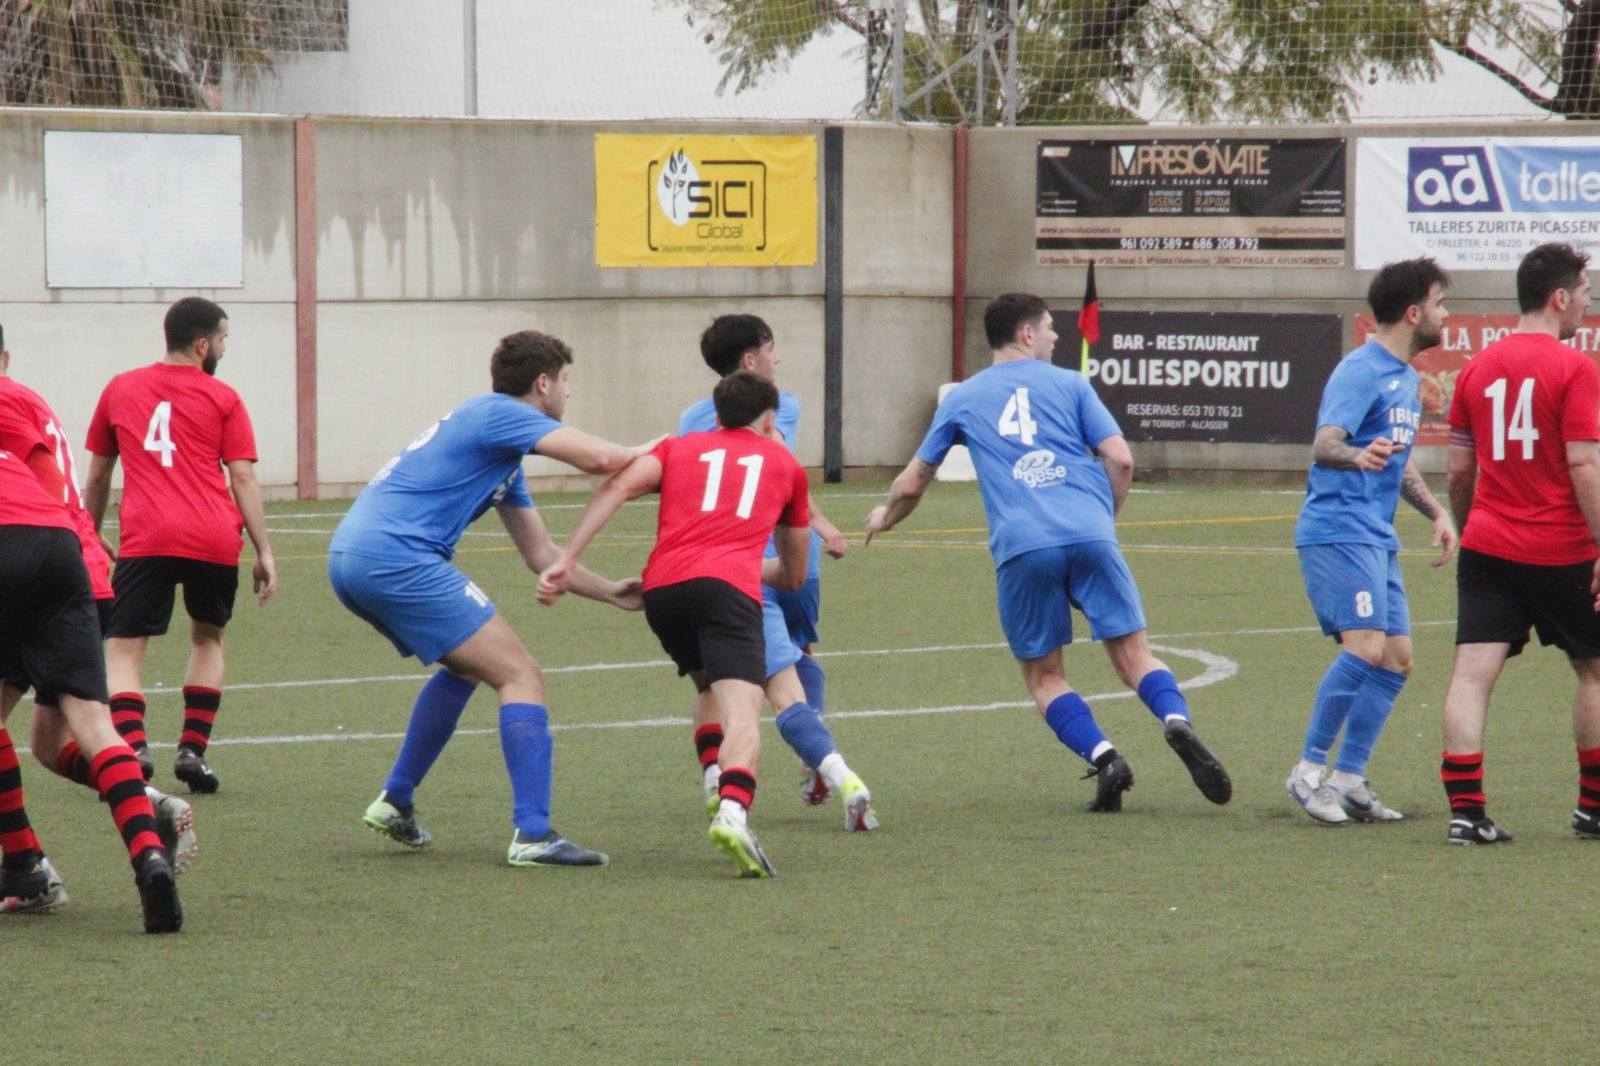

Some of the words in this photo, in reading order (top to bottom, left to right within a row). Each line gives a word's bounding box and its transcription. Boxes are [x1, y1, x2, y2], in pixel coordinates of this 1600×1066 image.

[1110, 141, 1270, 176] IMPRESIÓNATE
[1414, 154, 1490, 206] ad
[687, 181, 753, 218] SICI
[697, 223, 743, 239] Global
[1408, 221, 1474, 234] TALLERES
[1477, 221, 1526, 233] ZURITA
[1120, 238, 1137, 249] 961
[1140, 238, 1160, 249] 092
[1162, 238, 1182, 249] 589
[1192, 238, 1213, 250] 686
[1216, 238, 1236, 250] 208
[1239, 238, 1259, 250] 792
[1113, 335, 1144, 350] BAR
[1156, 335, 1259, 351] RESTAURANT
[1441, 327, 1471, 351] LA
[1088, 358, 1290, 389] POLIESPORTIU
[998, 388, 1037, 446] 4
[1127, 404, 1181, 416] RESERVAS:
[1182, 405, 1201, 416] 653
[1202, 405, 1215, 417] 70
[1217, 406, 1229, 417] 76
[1231, 406, 1243, 417] 21
[1140, 419, 1151, 428] AV
[1152, 420, 1186, 429] TORRENT
[1484, 378, 1539, 461] 14
[143, 401, 177, 468] 4
[700, 449, 765, 520] 11
[1355, 591, 1374, 618] 8
